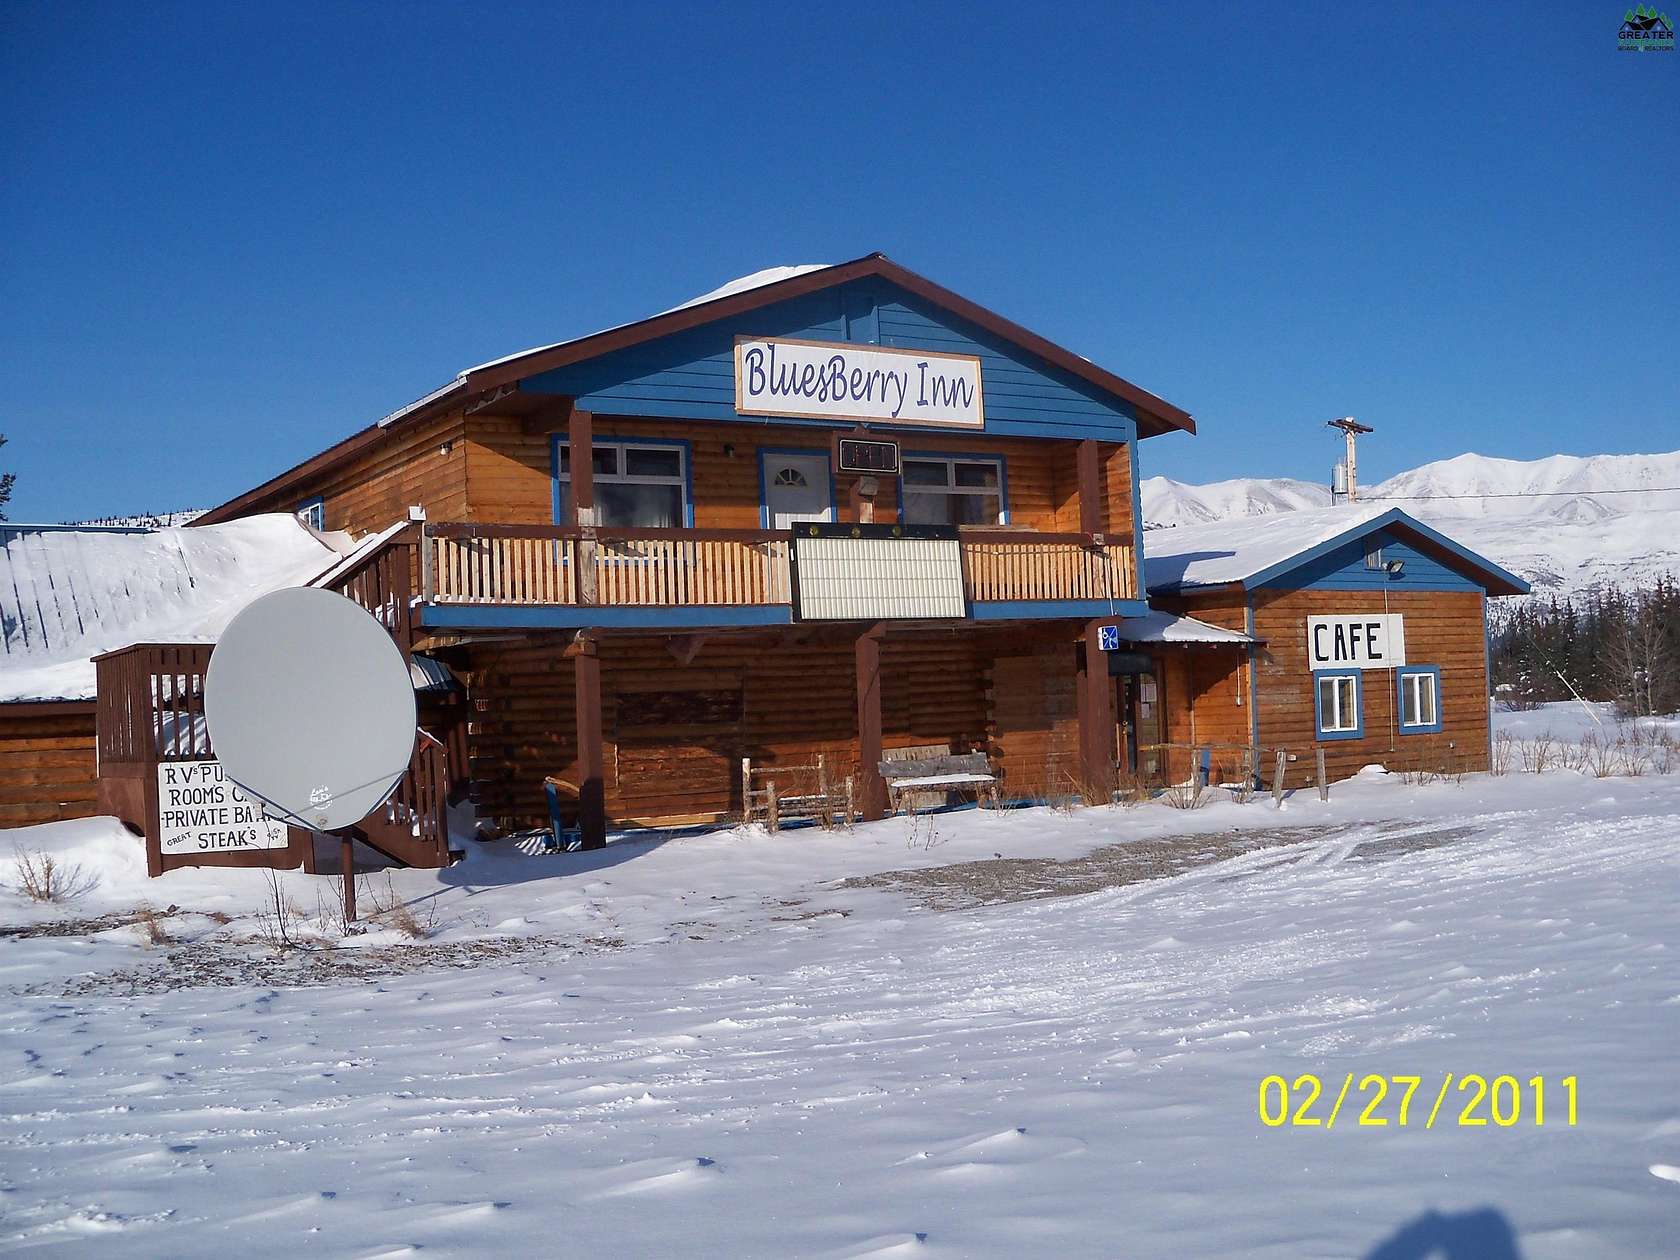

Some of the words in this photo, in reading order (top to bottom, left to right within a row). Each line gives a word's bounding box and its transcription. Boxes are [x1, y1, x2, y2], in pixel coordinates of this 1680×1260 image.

[745, 342, 908, 418] BluesBerry
[916, 361, 974, 408] Inn
[1313, 622, 1383, 662] CAFE
[166, 831, 192, 847] GREAT
